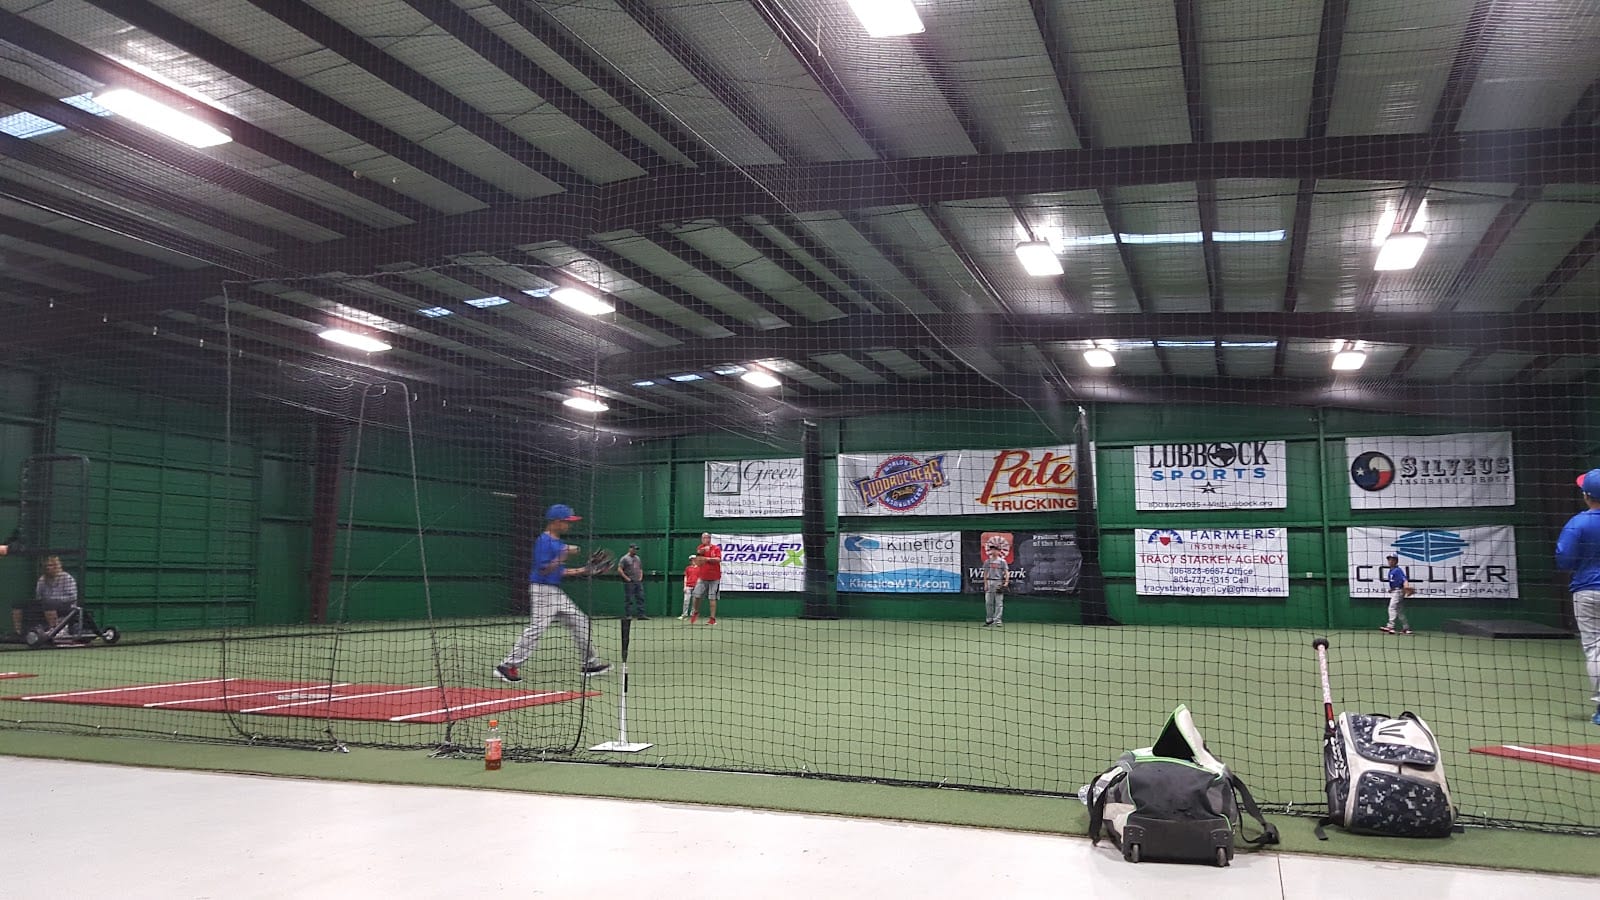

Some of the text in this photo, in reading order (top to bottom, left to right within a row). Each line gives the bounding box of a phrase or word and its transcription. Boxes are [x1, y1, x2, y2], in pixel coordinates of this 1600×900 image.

[1148, 441, 1270, 469] LUBBOCK
[1151, 467, 1267, 481] SPORTS
[1401, 456, 1511, 479] SILVEUS
[743, 460, 798, 491] Green
[976, 449, 1077, 507] Pate
[860, 459, 944, 507] FUDDRUCKERS
[991, 497, 1077, 511] TRUCKING
[1190, 529, 1276, 540] FARMERS
[887, 537, 955, 551] Kinetico
[723, 549, 804, 567] GRAPHIX
[887, 555, 954, 563] of West Texas
[1139, 554, 1284, 564] TRACY STARKEY AGENCY
[969, 567, 1027, 578] Wiark
[1227, 567, 1253, 575] Office
[1356, 565, 1509, 583] COLLIER
[849, 578, 950, 589] KineticoWTX.com
[1144, 584, 1281, 594] tracystarkeyagency@gmail.com
